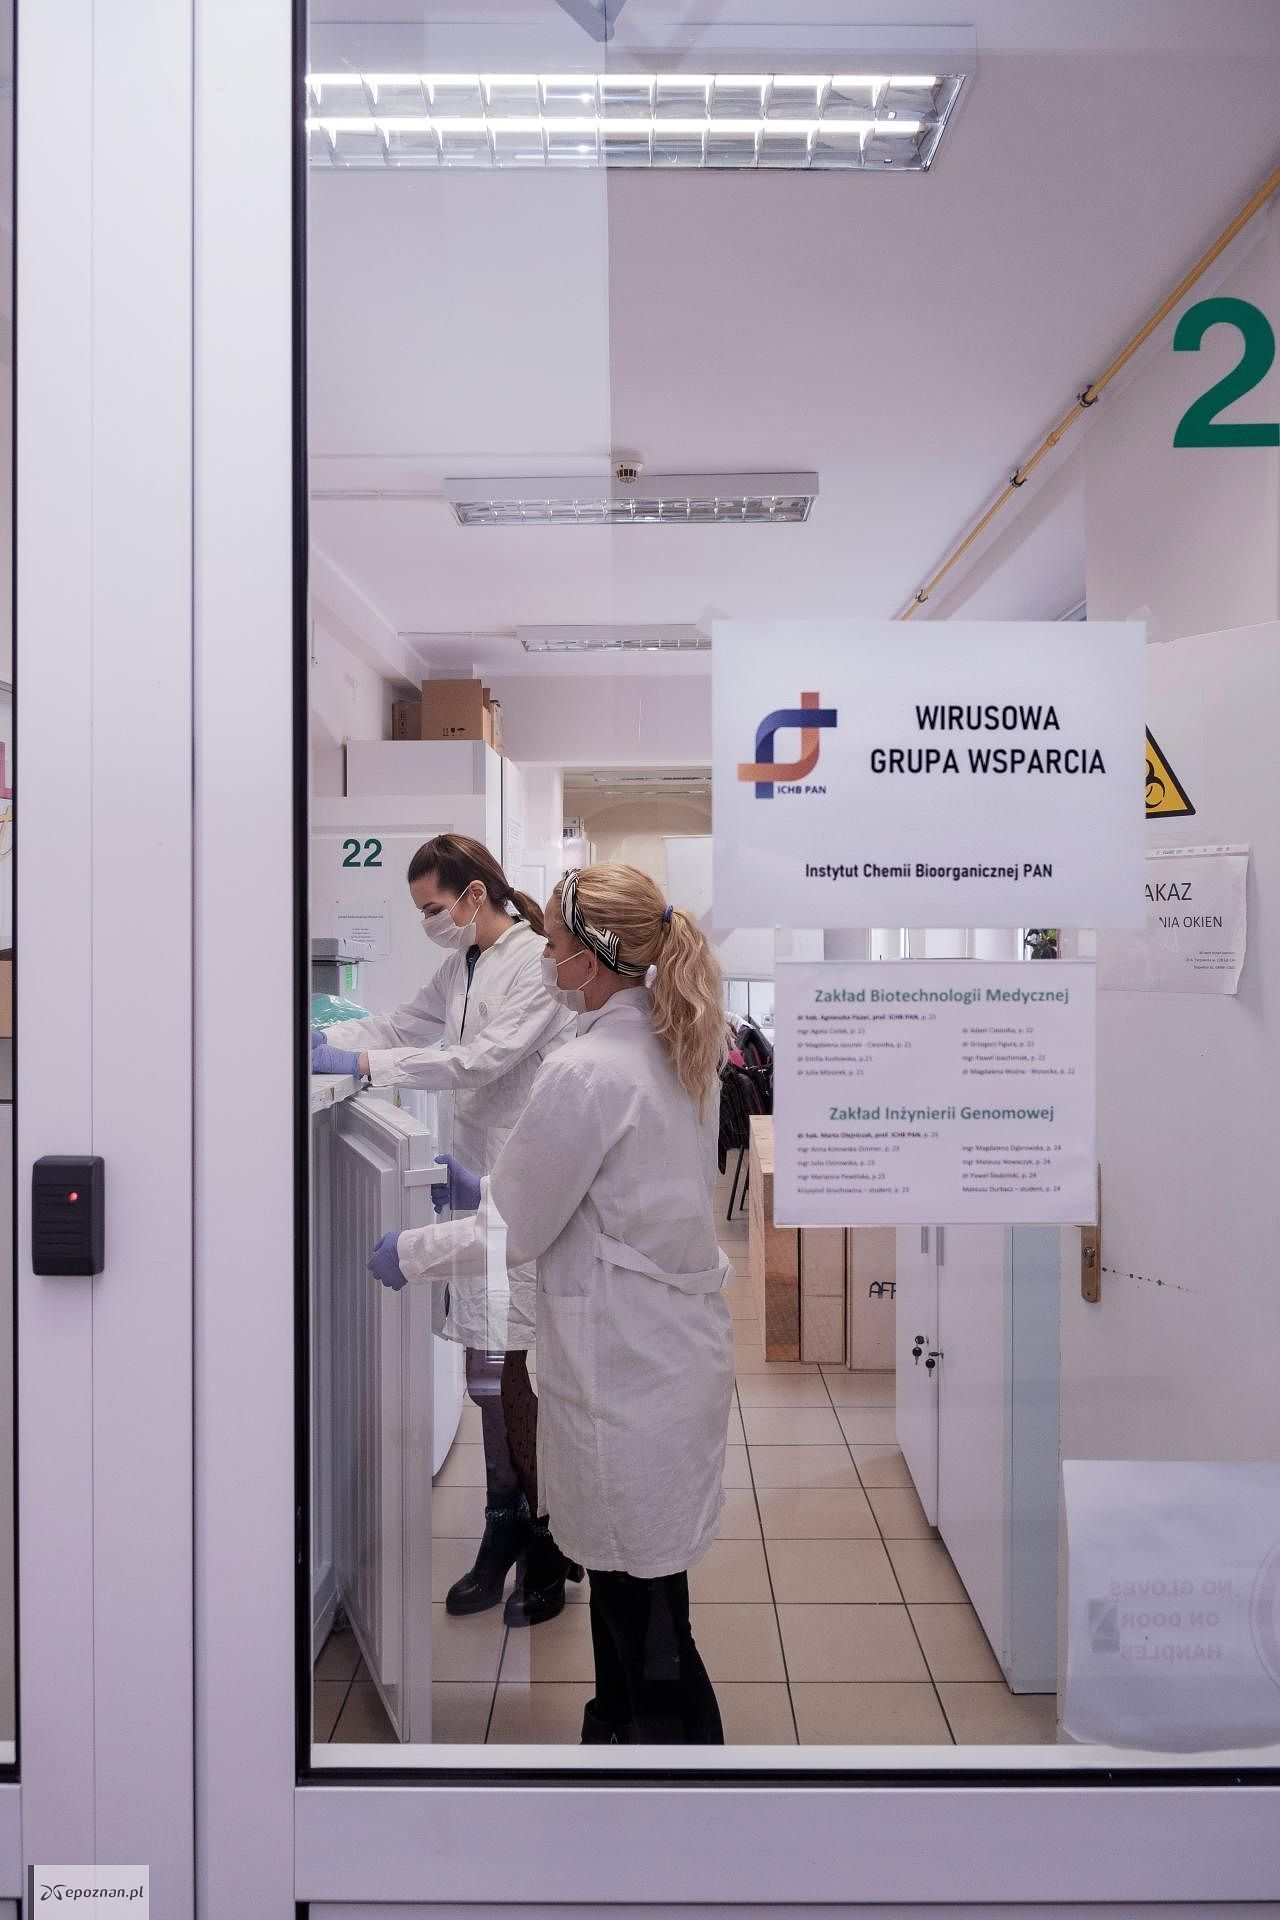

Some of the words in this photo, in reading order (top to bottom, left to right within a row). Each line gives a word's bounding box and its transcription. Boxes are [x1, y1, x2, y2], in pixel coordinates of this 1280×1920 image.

[1173, 297, 1280, 448] 2
[916, 706, 1060, 730] WIRUSOWA
[871, 749, 960, 774] GRUPA
[968, 749, 1106, 774] WSPARCIA
[777, 786, 802, 794] ICHB
[805, 786, 827, 794] PAN
[342, 839, 382, 867] 22
[806, 864, 858, 880] Instytut
[864, 864, 910, 878] Chemii
[916, 864, 1018, 881] Bioorganicznej
[1024, 864, 1052, 877] PAN
[1183, 916, 1223, 928] OKIEN
[815, 989, 865, 1002] Zakład
[871, 988, 980, 1005] Biotechnologii
[986, 988, 1068, 1004] Medycznej
[830, 1106, 880, 1120] Zakład
[886, 1106, 955, 1122] Inżynierii
[960, 1106, 1054, 1122] Genomowej
